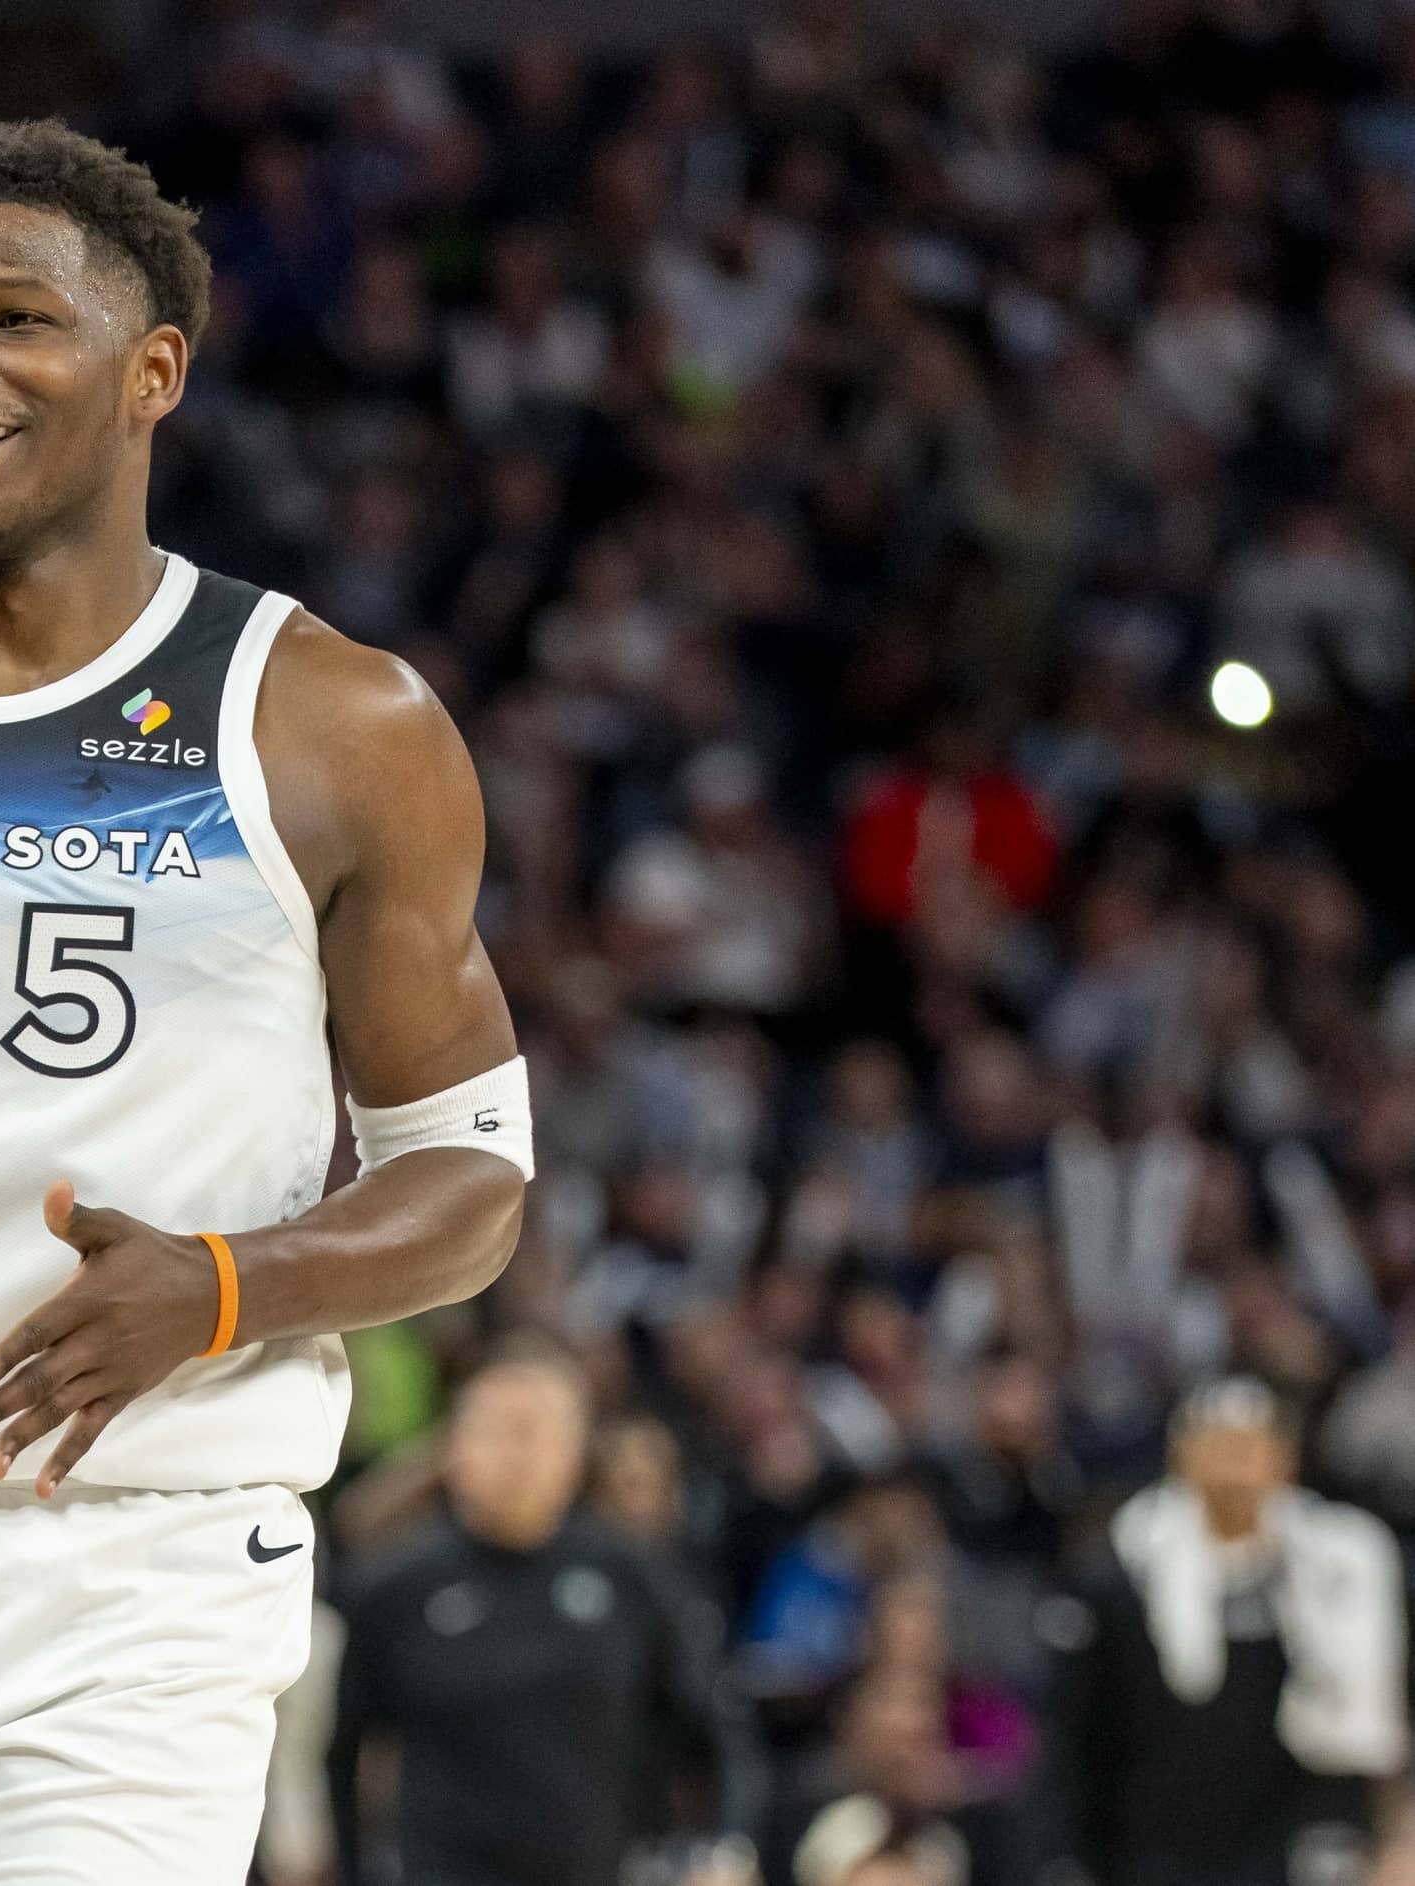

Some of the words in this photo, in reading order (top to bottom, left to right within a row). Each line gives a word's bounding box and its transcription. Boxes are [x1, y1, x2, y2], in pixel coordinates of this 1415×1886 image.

[80, 736, 206, 768] sezzle
[0, 902, 136, 1079] 5
[473, 1108, 499, 1132] 5
